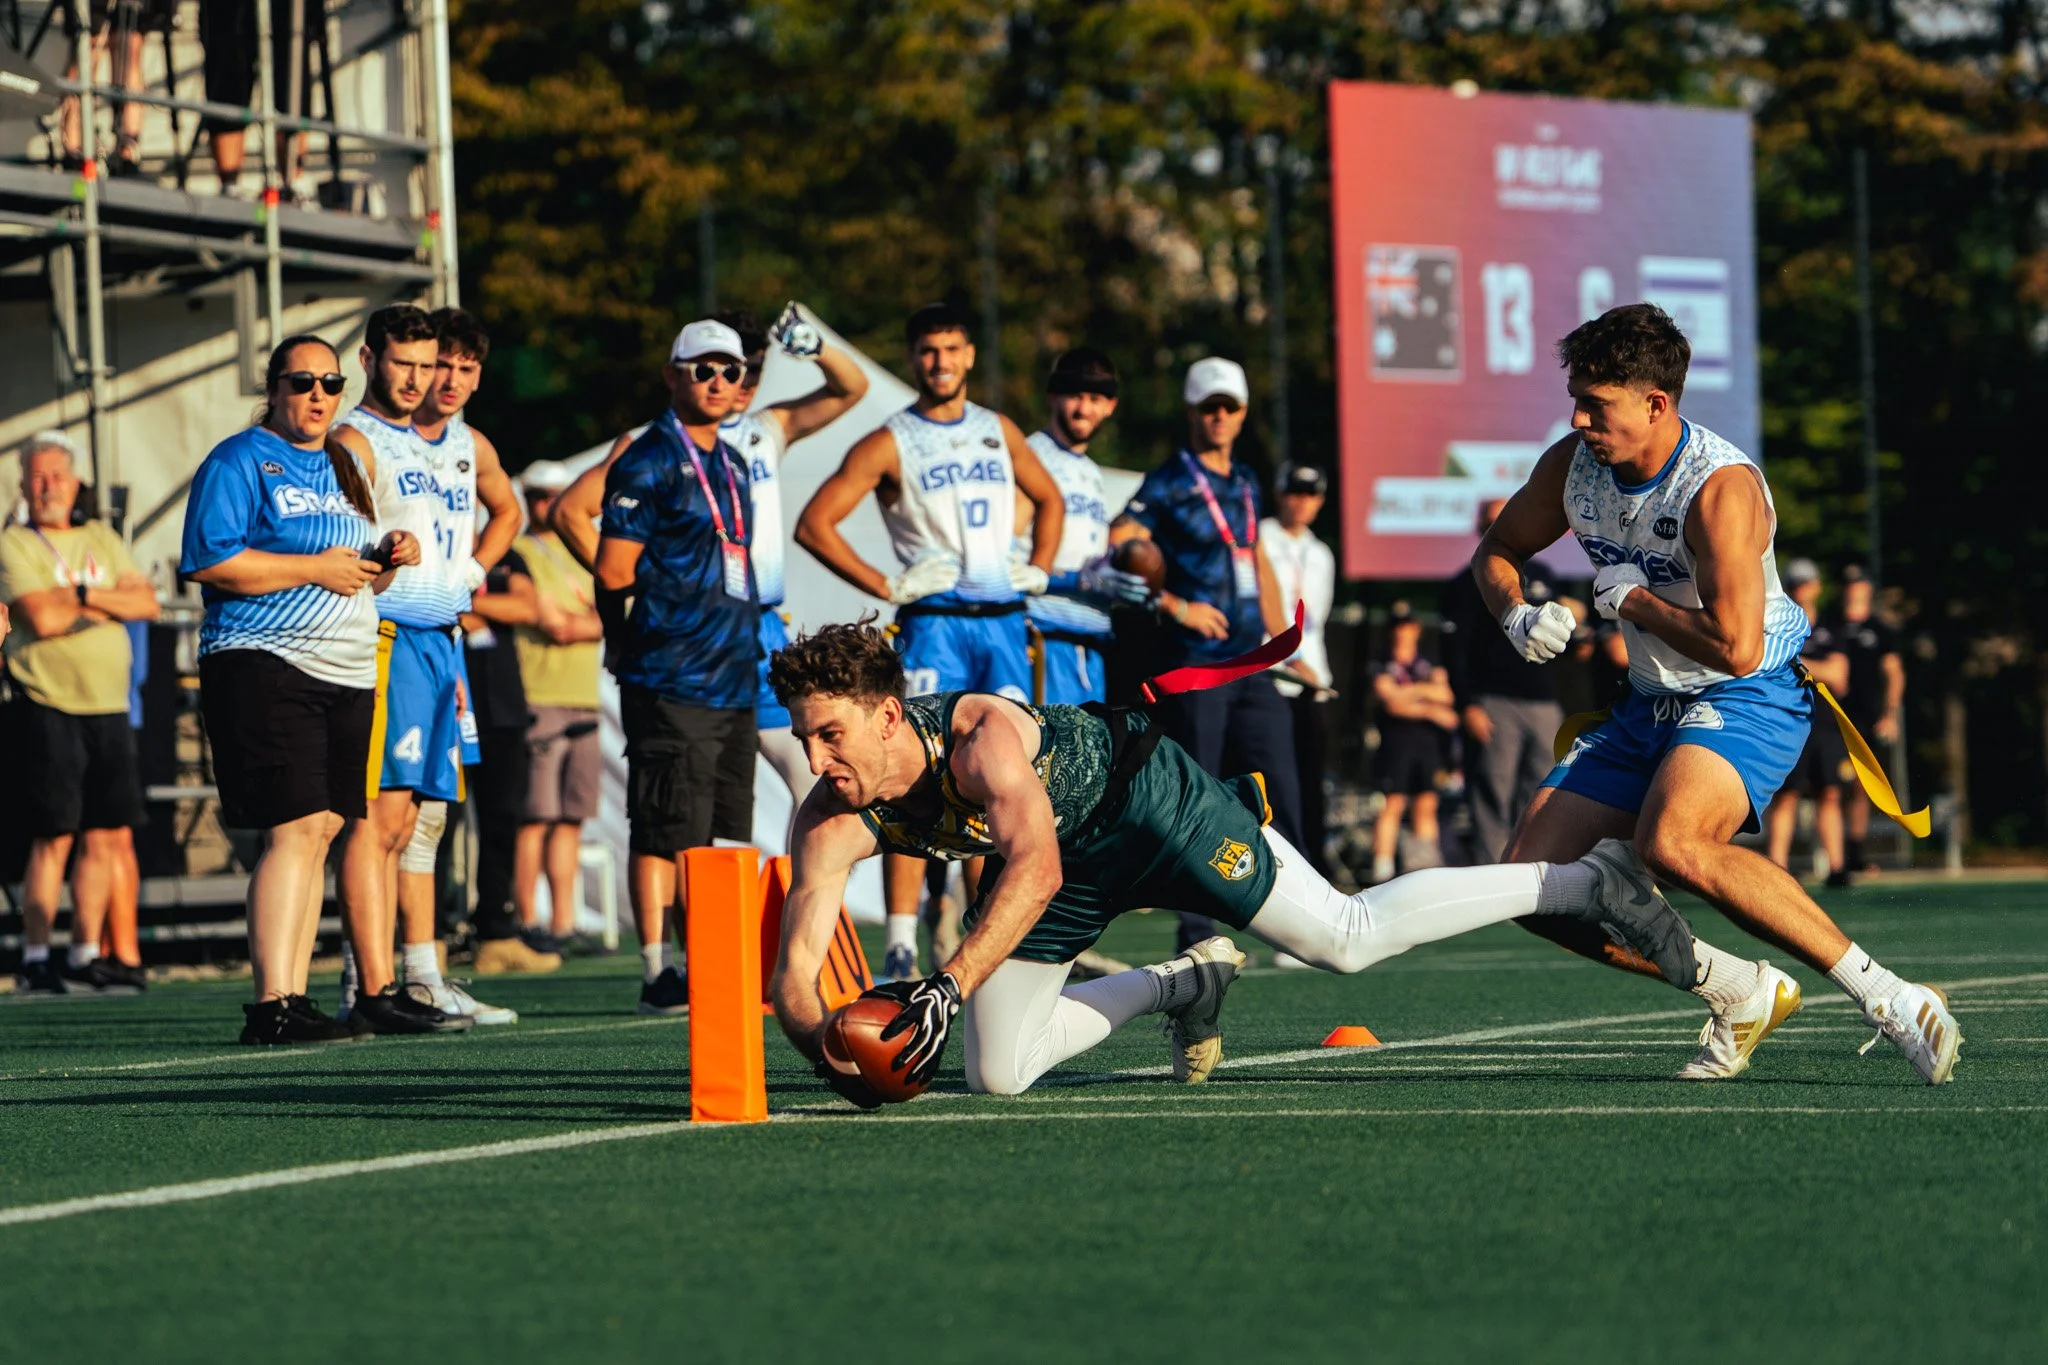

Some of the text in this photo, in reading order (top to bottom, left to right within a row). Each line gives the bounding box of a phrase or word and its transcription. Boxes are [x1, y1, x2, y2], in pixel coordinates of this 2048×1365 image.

[1482, 262, 1535, 375] 13
[920, 460, 1007, 492] ISRAEL
[962, 499, 989, 528] 10
[1655, 522, 1678, 535] MHK
[393, 725, 422, 764] 4
[1217, 843, 1248, 878] AFA
